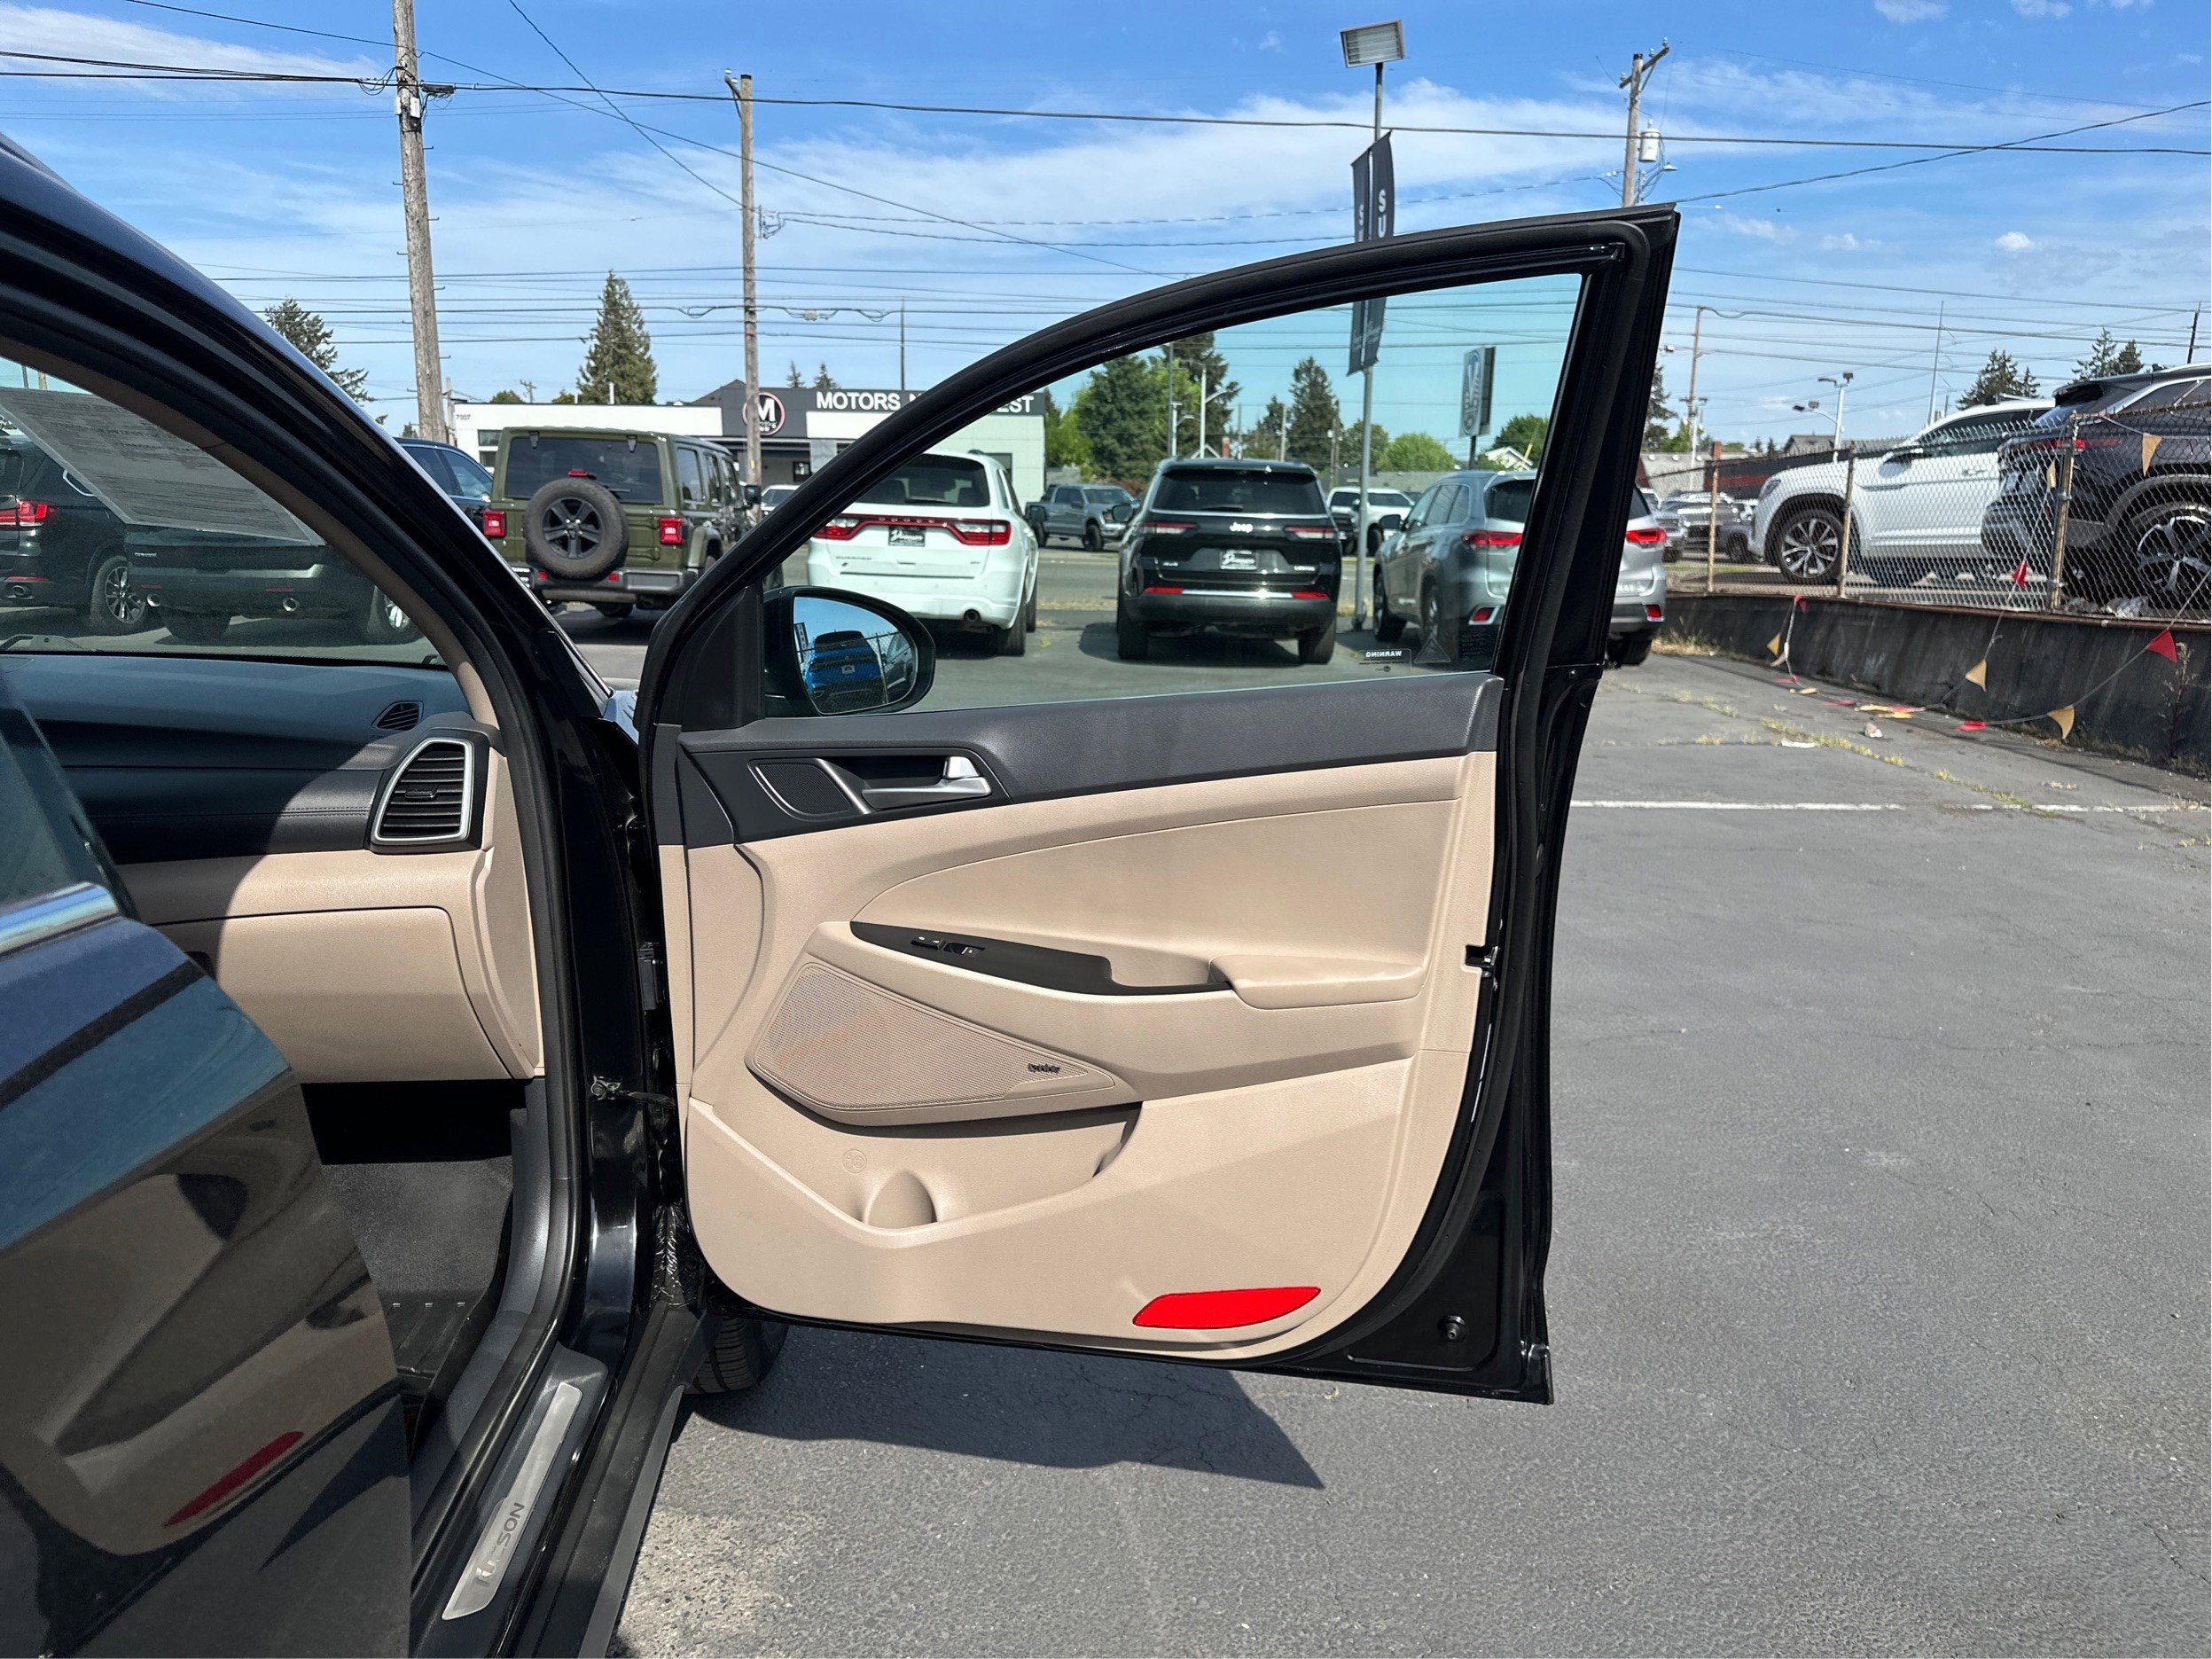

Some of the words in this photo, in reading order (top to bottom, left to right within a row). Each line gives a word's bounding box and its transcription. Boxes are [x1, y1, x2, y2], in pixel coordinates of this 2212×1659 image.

[1378, 189, 1387, 239] SU
[756, 397, 776, 422] M
[816, 391, 901, 411] MOTORS
[1229, 521, 1254, 533] Jeep
